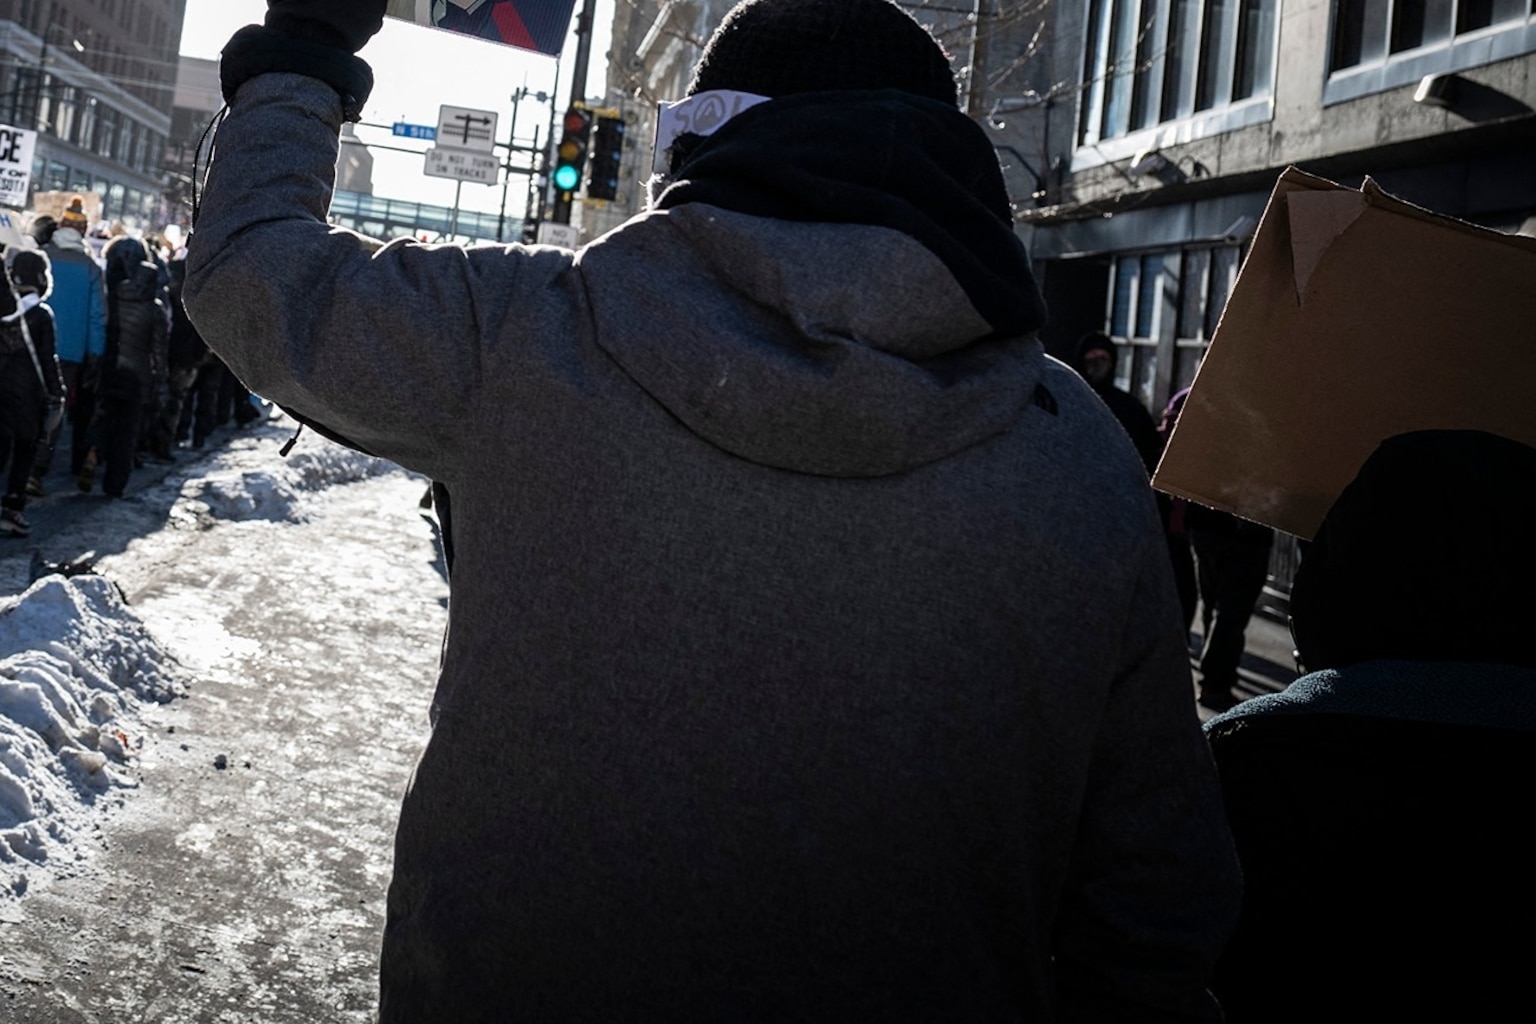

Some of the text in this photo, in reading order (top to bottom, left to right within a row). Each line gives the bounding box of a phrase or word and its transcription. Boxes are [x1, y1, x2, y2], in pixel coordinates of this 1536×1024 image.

[430, 152, 495, 169] DO NOT TURN
[8, 168, 28, 177] OF
[435, 163, 486, 179] ON TRACKS
